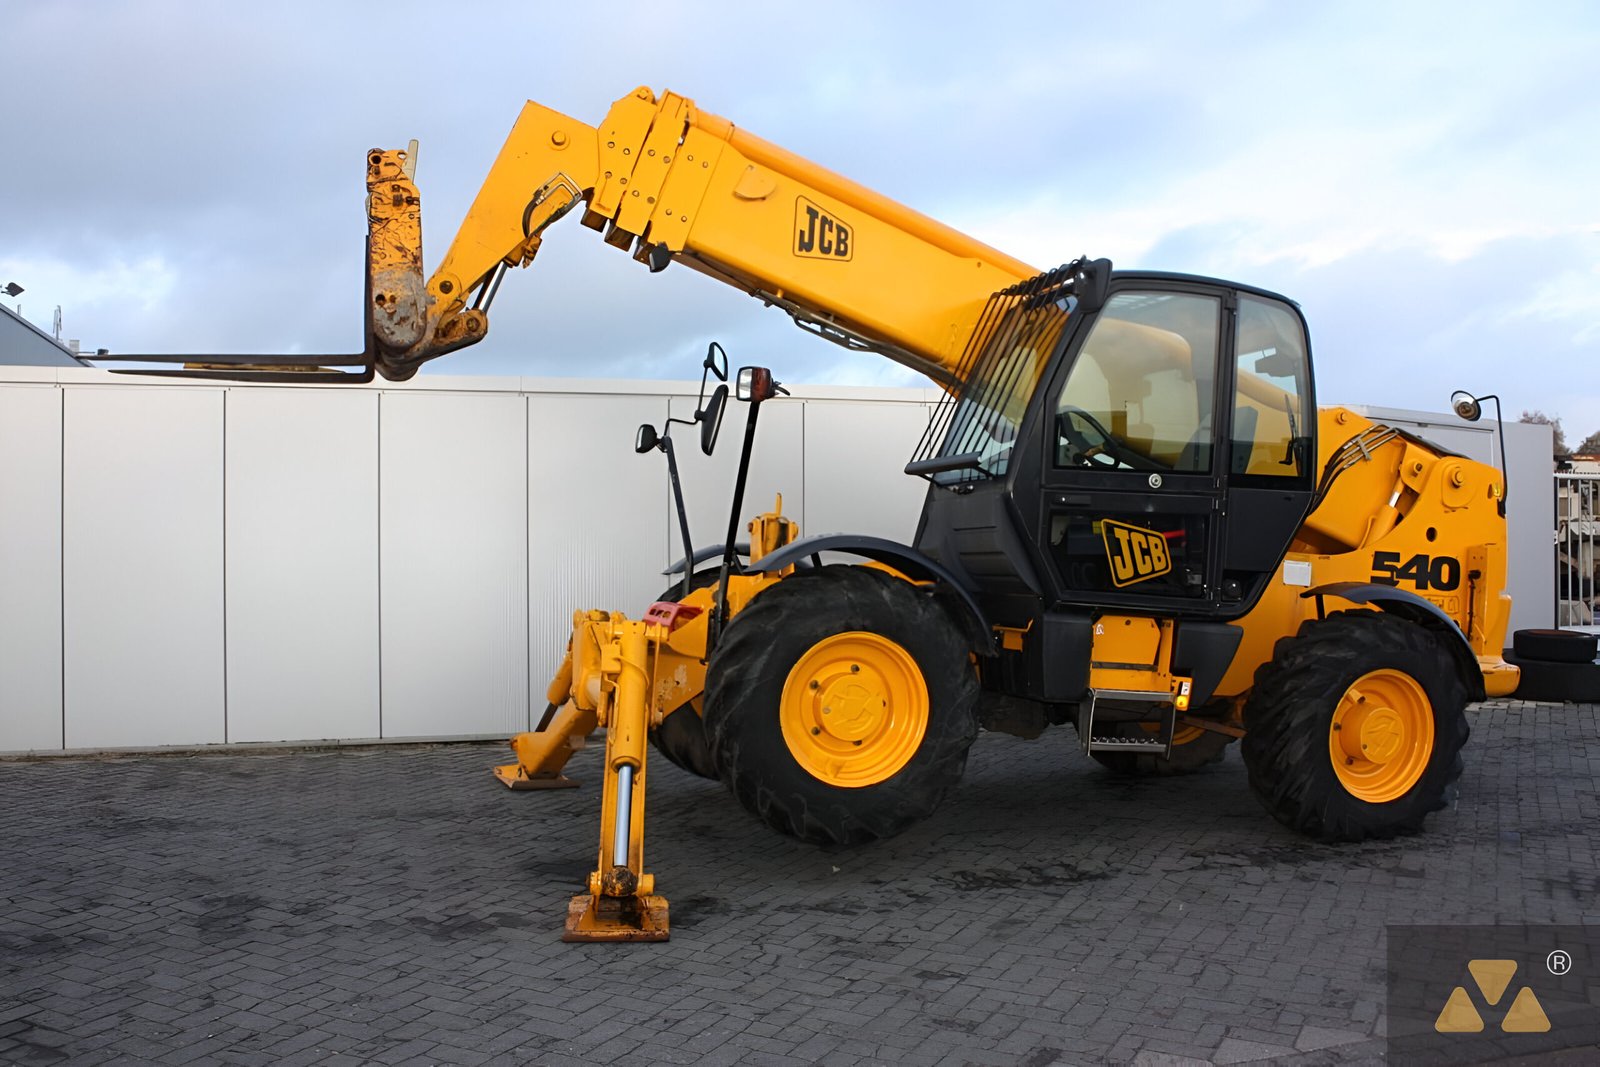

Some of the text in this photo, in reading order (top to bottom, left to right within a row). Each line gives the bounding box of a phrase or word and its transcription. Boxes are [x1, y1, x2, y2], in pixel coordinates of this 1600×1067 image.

[798, 205, 849, 257] JCB
[1113, 527, 1167, 580] JCB
[1370, 551, 1460, 591] 540
